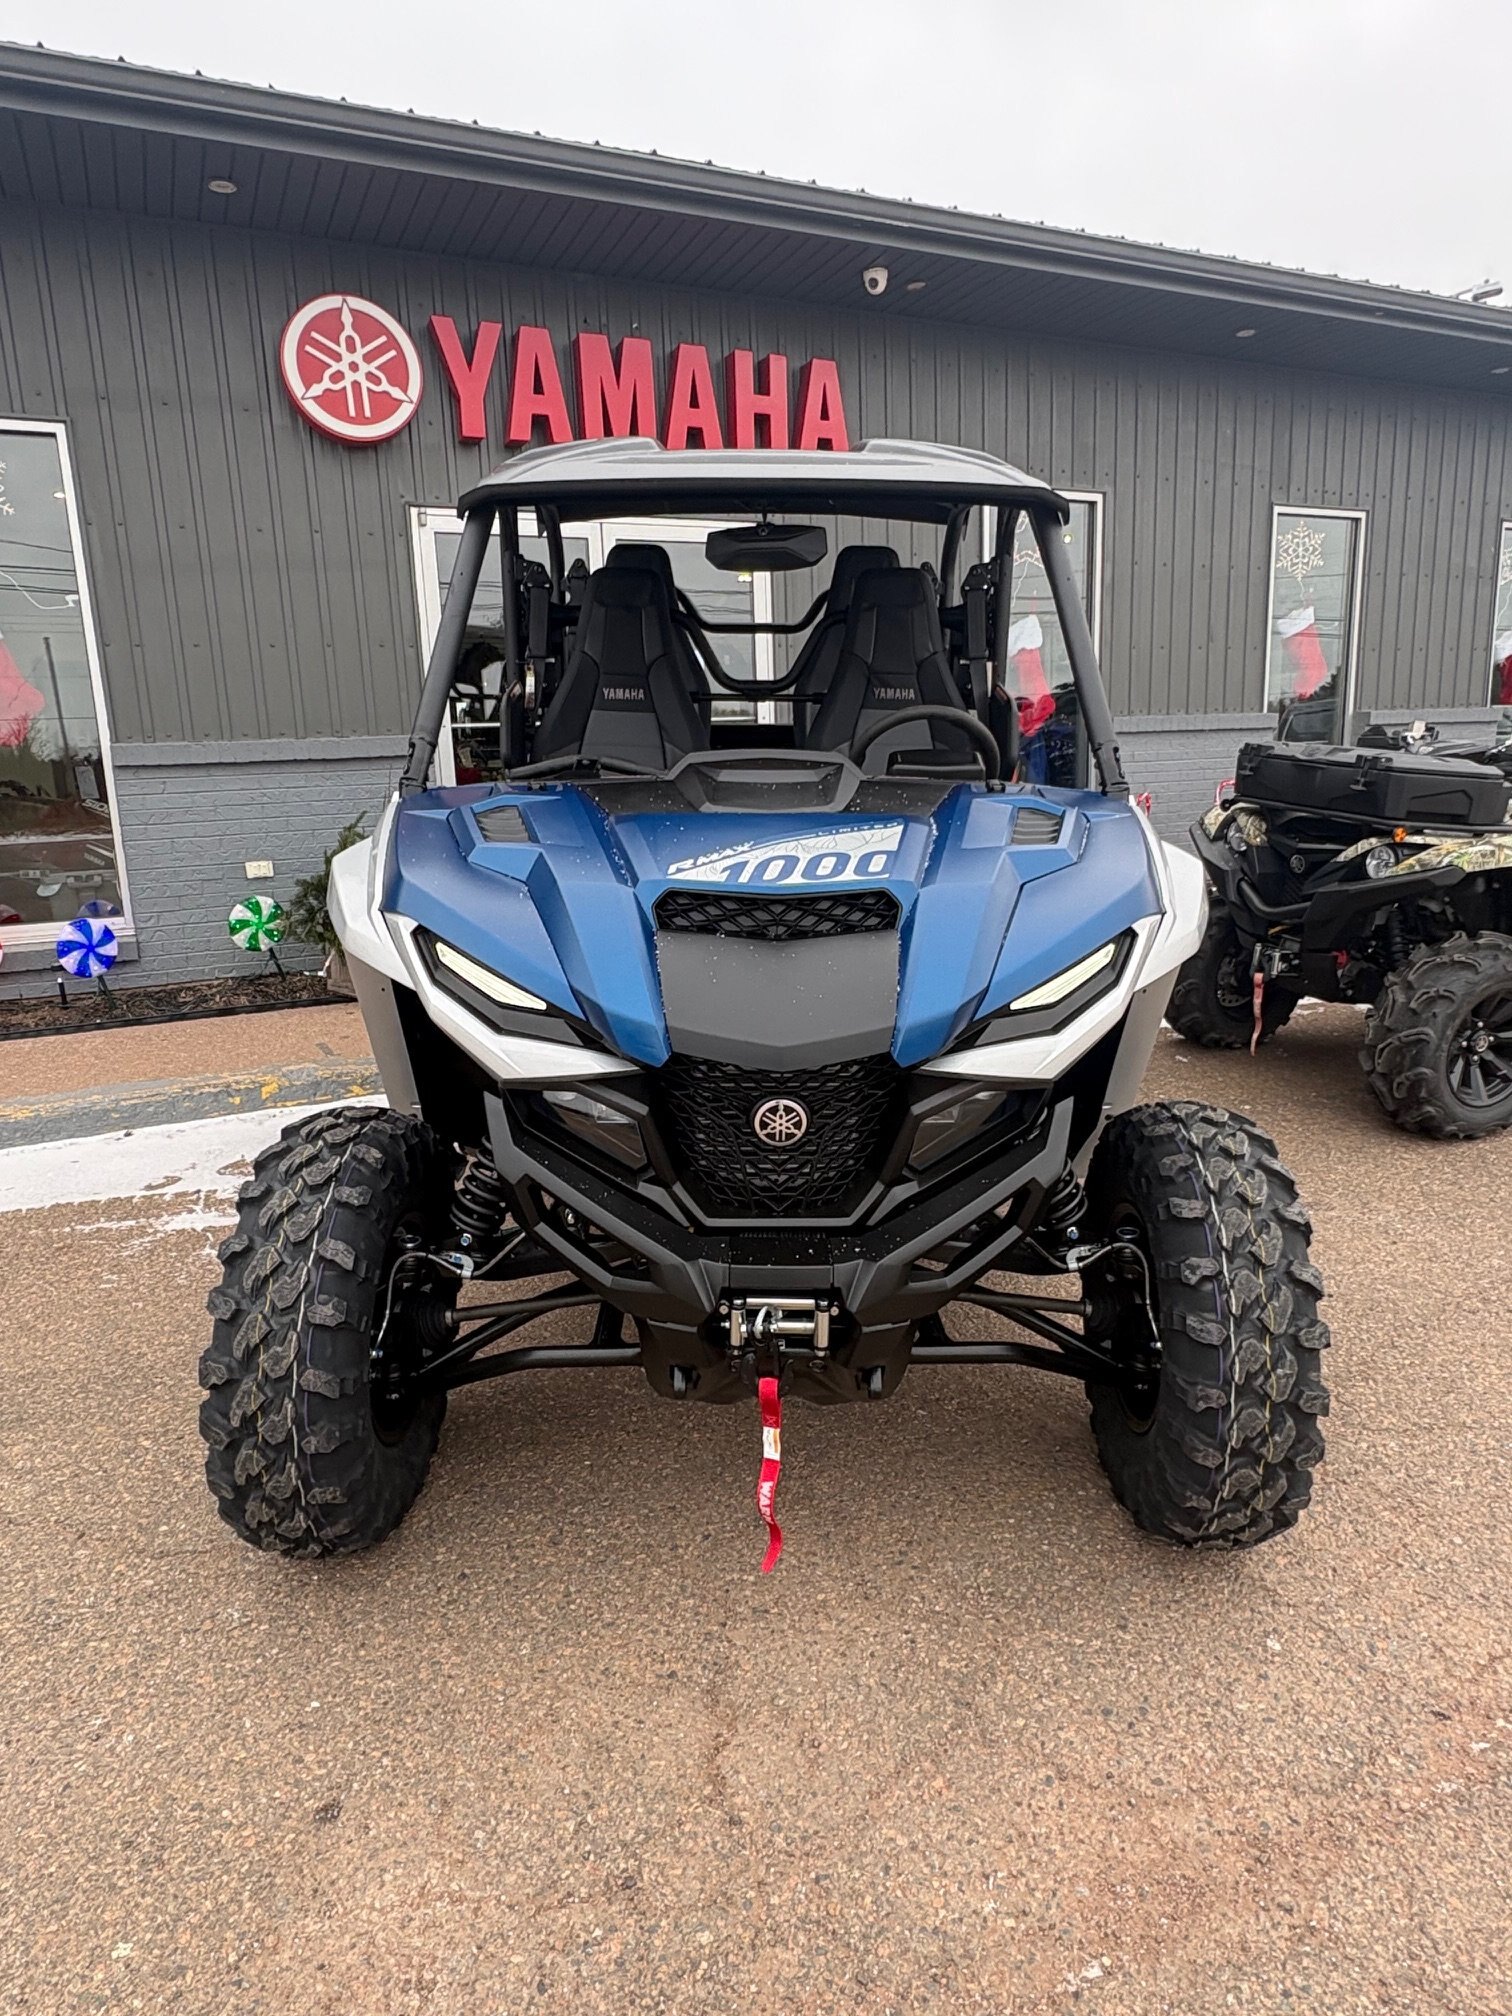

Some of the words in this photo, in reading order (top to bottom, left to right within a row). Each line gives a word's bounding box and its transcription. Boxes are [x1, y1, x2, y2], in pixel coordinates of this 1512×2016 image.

[428, 314, 850, 452] YAMAHA
[602, 687, 645, 700] YAMAHA
[873, 687, 915, 700] YAMAHA
[667, 841, 755, 874] RMAX
[720, 851, 893, 884] 1000
